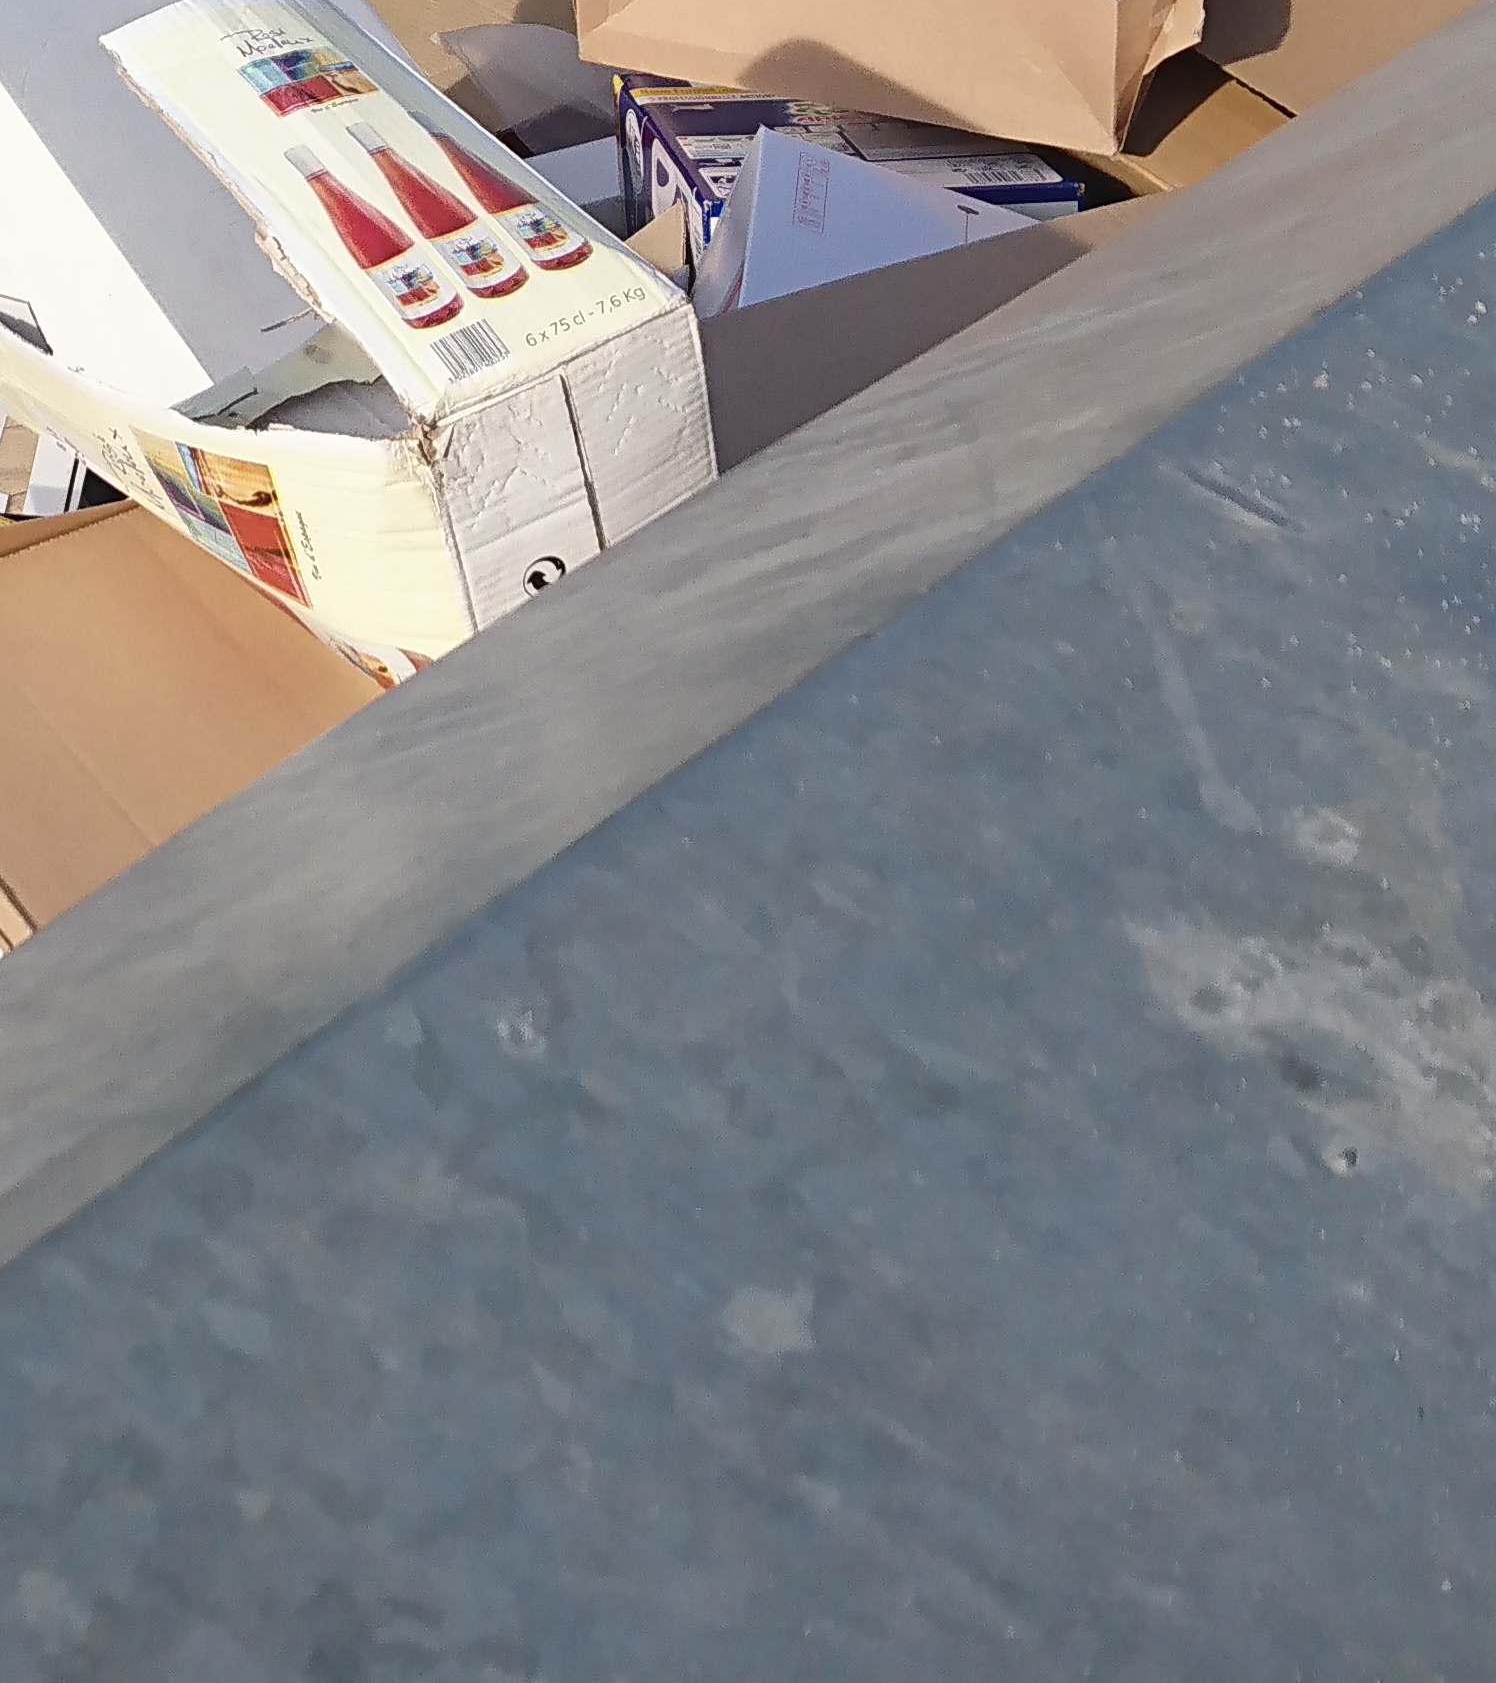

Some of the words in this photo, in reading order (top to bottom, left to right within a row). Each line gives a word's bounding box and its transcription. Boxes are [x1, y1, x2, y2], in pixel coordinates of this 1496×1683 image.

[525, 332, 538, 348] 6
[538, 331, 550, 343] x
[549, 317, 571, 337] 75
[572, 310, 587, 327] cl
[594, 293, 622, 315] 7,6
[622, 285, 647, 305] Kg
